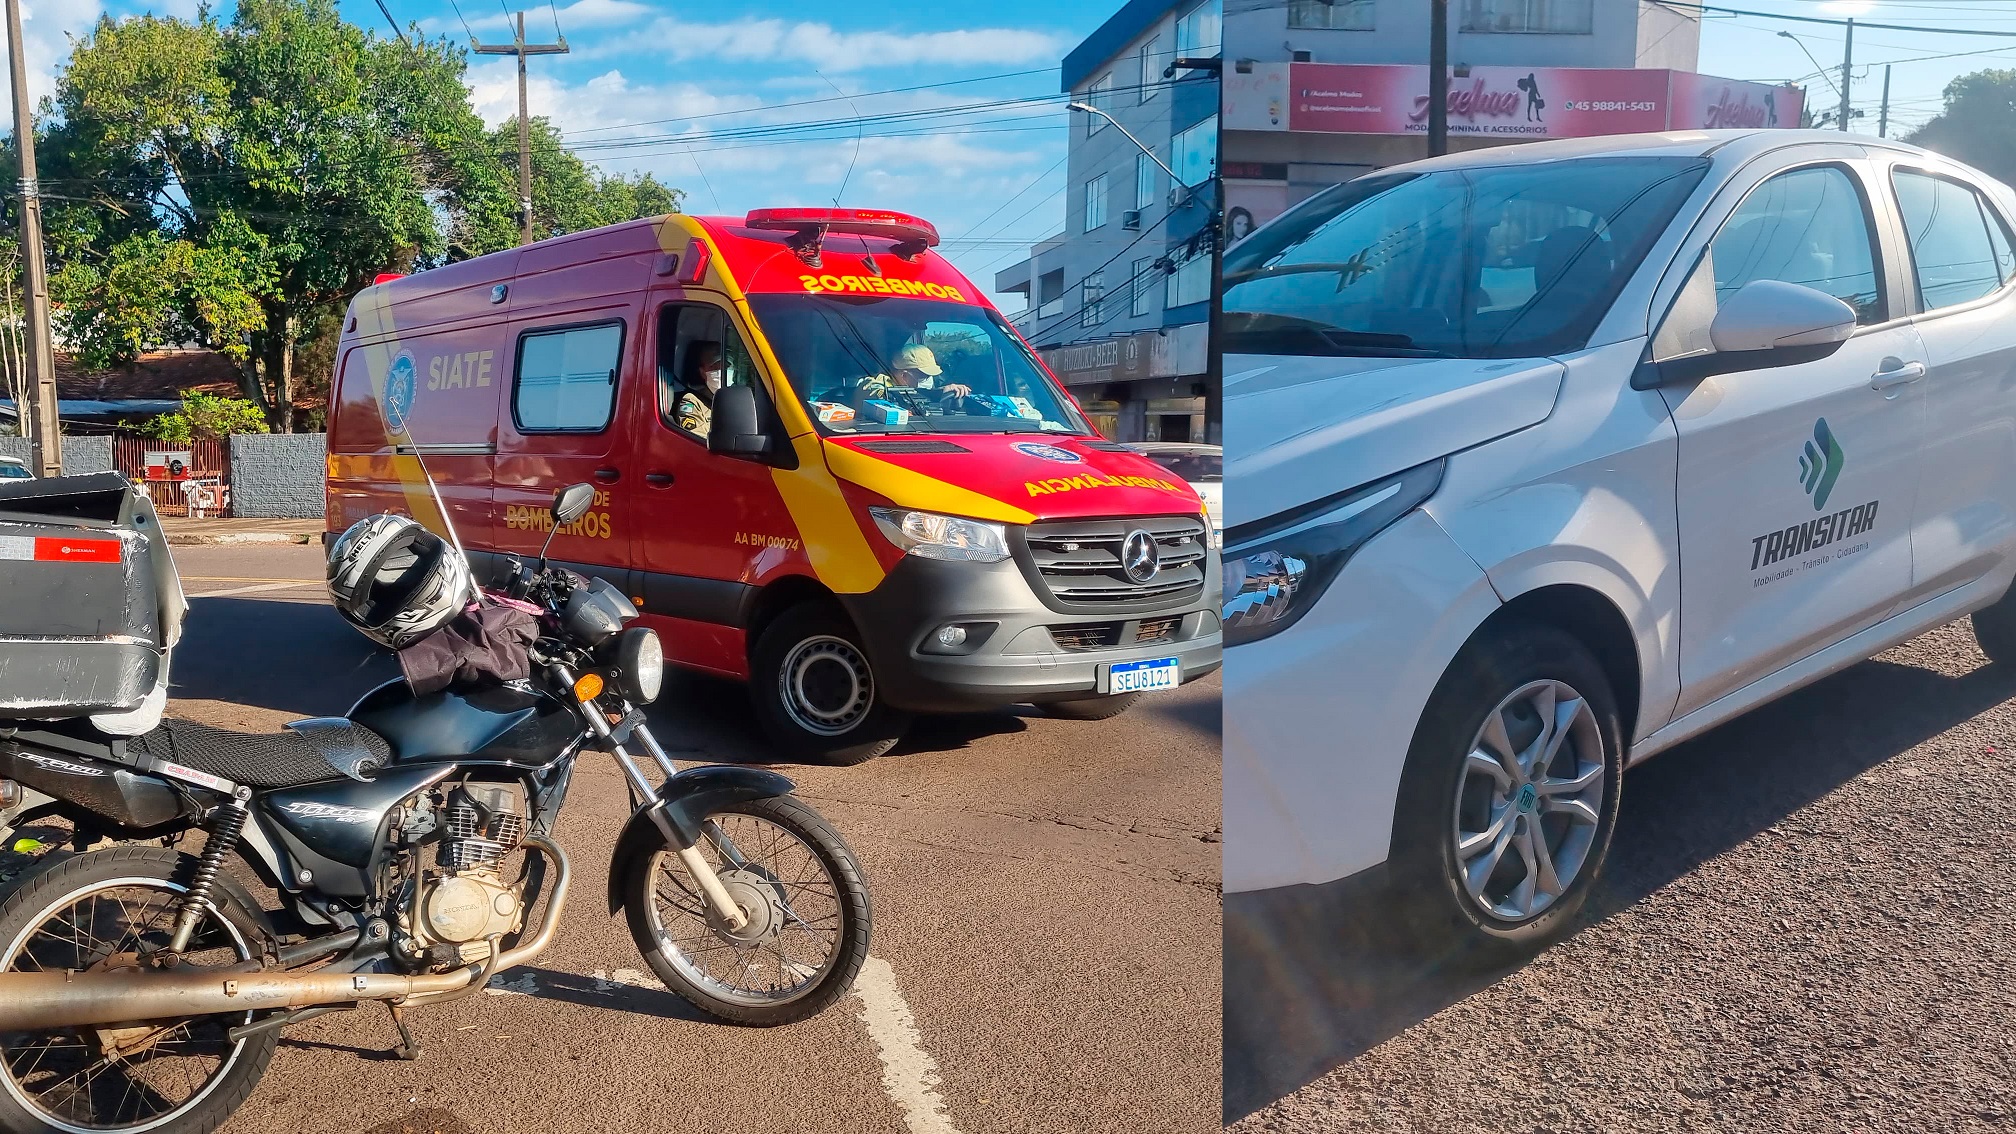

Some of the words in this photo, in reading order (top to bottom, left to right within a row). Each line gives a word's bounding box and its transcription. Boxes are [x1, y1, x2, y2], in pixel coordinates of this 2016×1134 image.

[1574, 101, 1589, 110] 45
[1592, 101, 1655, 111] 98841-5431
[1484, 125, 1489, 133] E
[1491, 124, 1548, 134] ACESSÓRIOS
[427, 349, 494, 391] SIATE
[594, 490, 611, 507] DE
[351, 534, 372, 558] HELT
[734, 531, 749, 545] AA
[751, 533, 766, 547] BM
[767, 535, 799, 552] 00074
[1750, 500, 1879, 571] TRANSITAR
